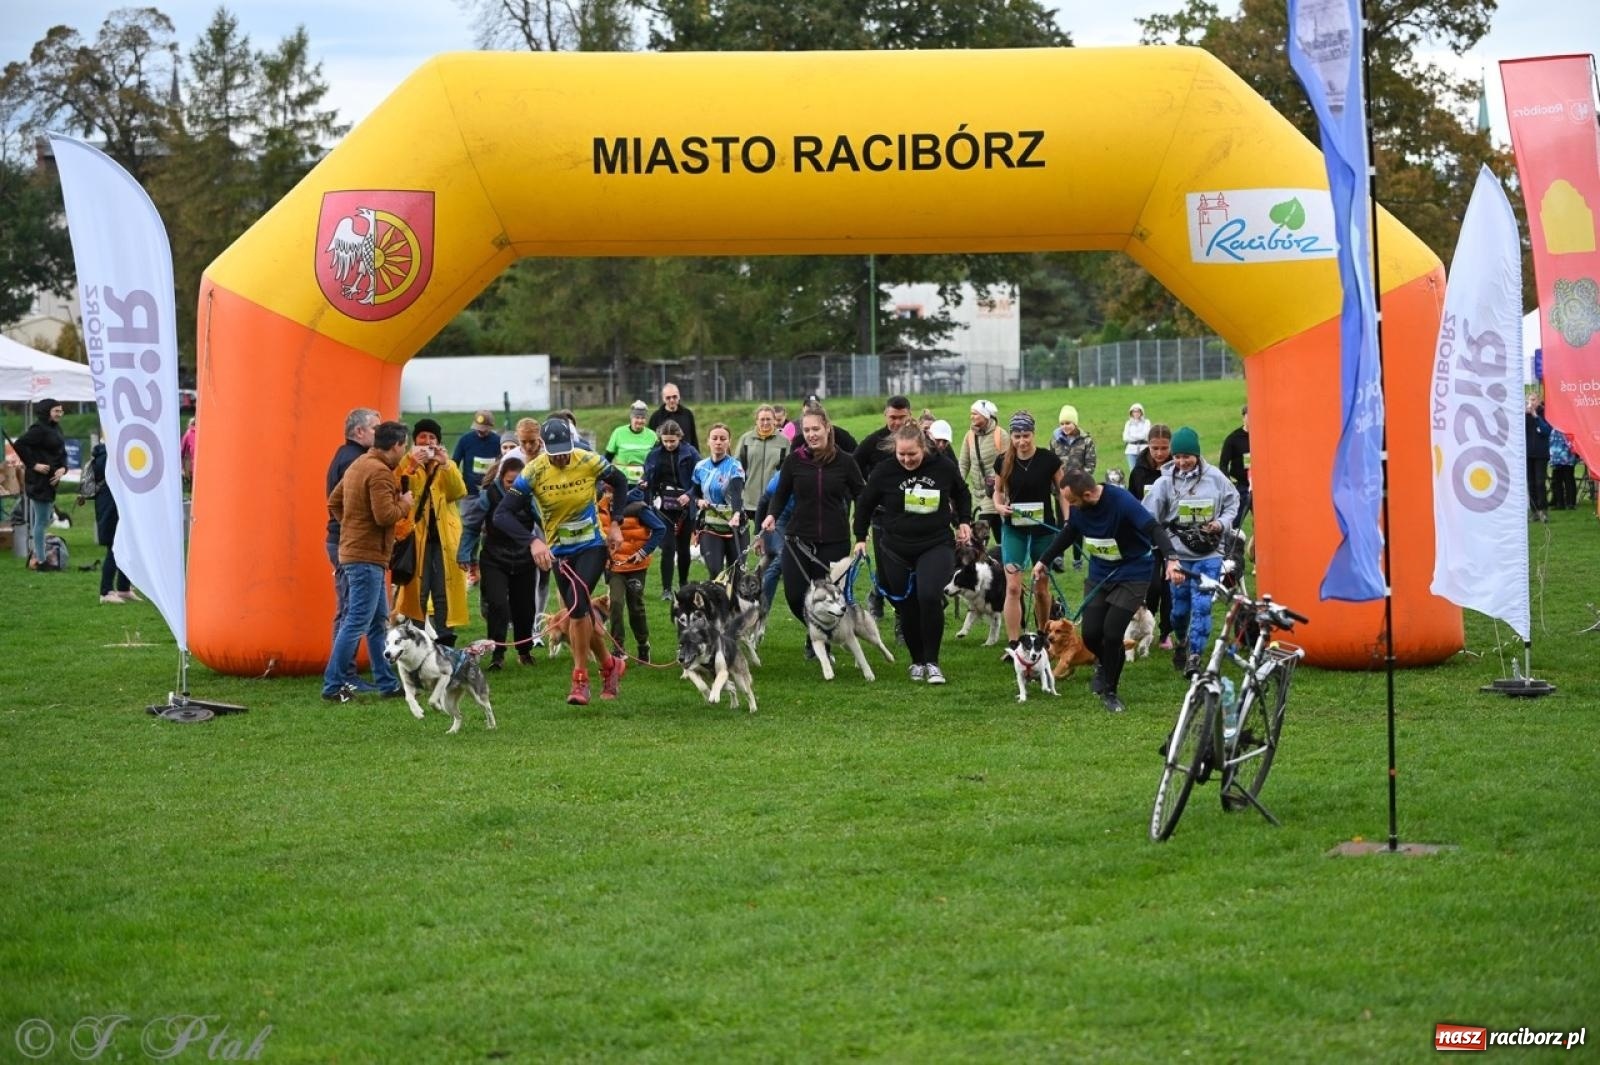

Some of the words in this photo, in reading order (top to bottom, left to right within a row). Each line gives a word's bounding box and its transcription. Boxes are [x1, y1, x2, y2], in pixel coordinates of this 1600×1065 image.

[593, 136, 777, 174] MIASTO
[793, 124, 1046, 173] RACIBÓRZ
[1205, 218, 1334, 261] Racibórz
[919, 496, 926, 506] 3
